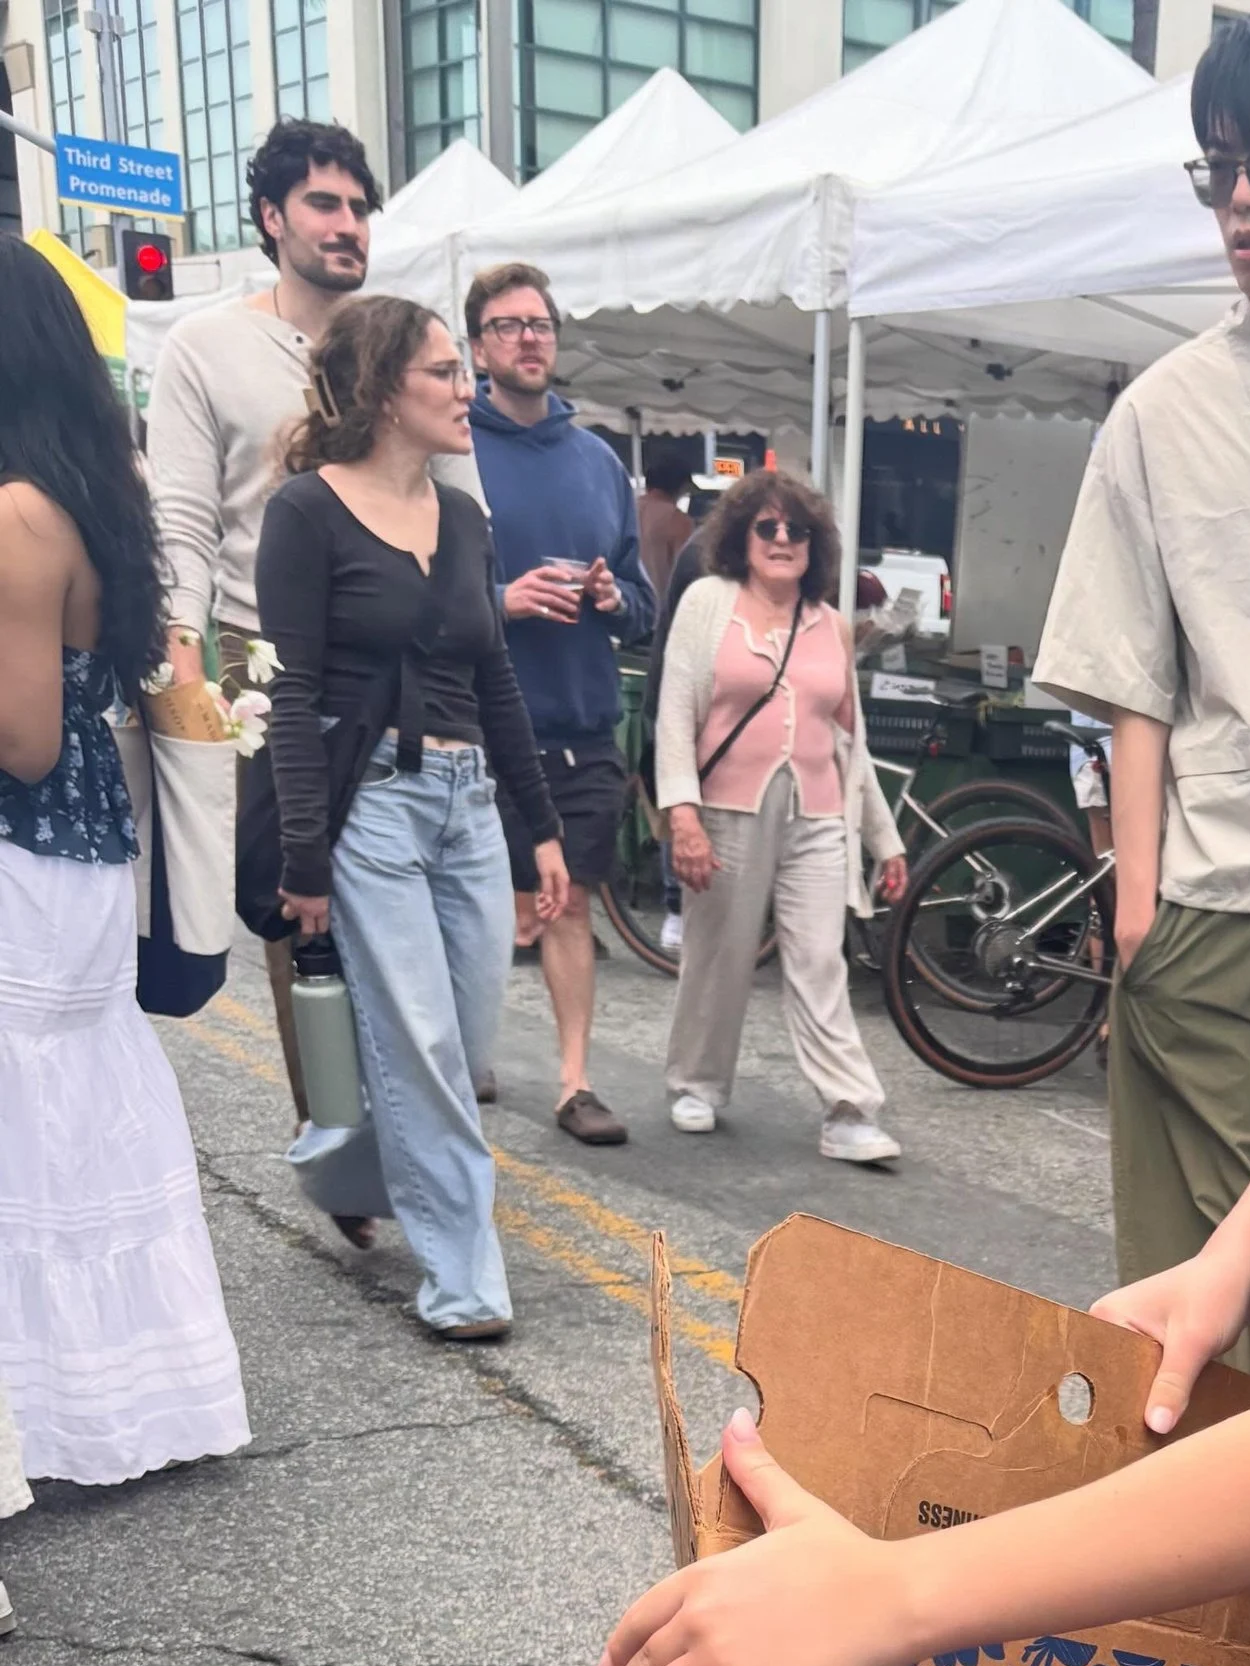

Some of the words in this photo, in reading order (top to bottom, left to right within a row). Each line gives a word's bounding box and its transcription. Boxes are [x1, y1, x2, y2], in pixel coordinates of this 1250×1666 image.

[64, 147, 111, 171] Third
[118, 156, 174, 181] Street
[69, 174, 172, 207] Promenade
